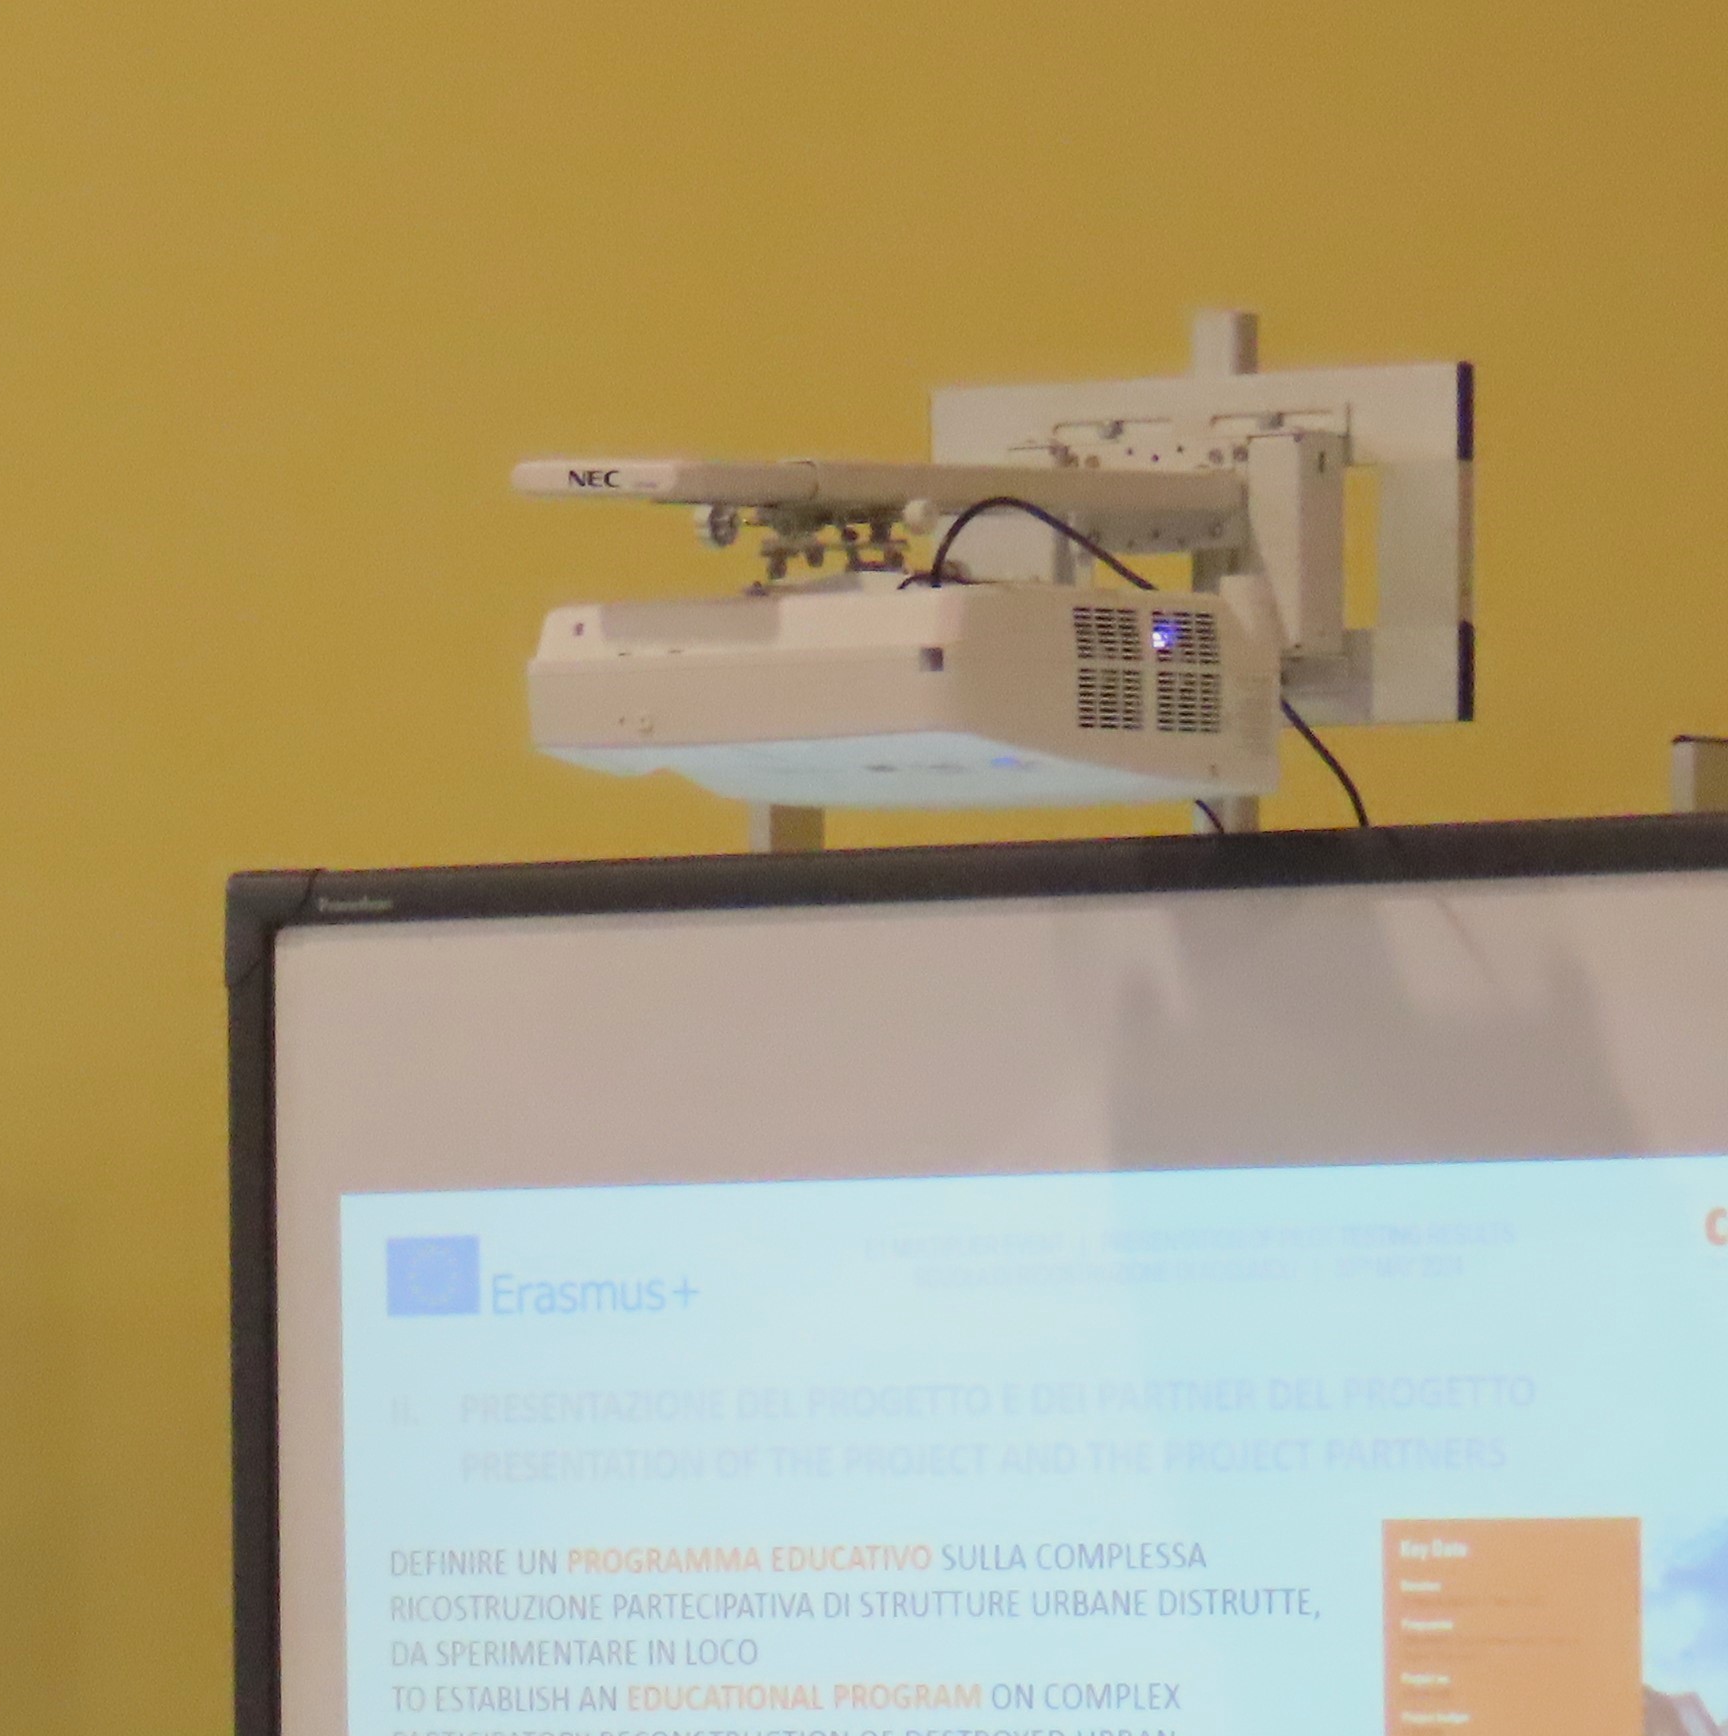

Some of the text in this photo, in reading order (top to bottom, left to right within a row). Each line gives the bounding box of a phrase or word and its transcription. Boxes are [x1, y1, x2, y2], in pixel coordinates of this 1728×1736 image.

[568, 468, 621, 488] NEC
[490, 1272, 700, 1317] Erasmus+
[460, 1389, 725, 1424] PRESENTAZIONE
[737, 1387, 796, 1420] DEL
[807, 1383, 992, 1419] PROGETTO
[1002, 1382, 1022, 1414] E
[1030, 1381, 1087, 1415] DEI
[1097, 1378, 1255, 1413] PARTNER
[1269, 1376, 1331, 1411] DEL
[1343, 1375, 1537, 1409] PROGETTO
[462, 1438, 1508, 1484] PRESENTATION OF THE PROJECT AND THE PROJECT PARTNERS
[391, 1541, 1208, 1576] DEFINIRE UN PROGRAMMA EDUCATIVO SULLA COMPLESSA
[391, 1588, 1321, 1622] RICOSTRUZIONE PARTECIPATIVA DI STRUTTURE URBANE DISTRUTTE,
[391, 1638, 759, 1667] DA SPERIMENTARE IN LOCO
[392, 1682, 1181, 1712] TO ESTABLISH AN EDUCATIONAL PROGRAM ON COMPLEX
